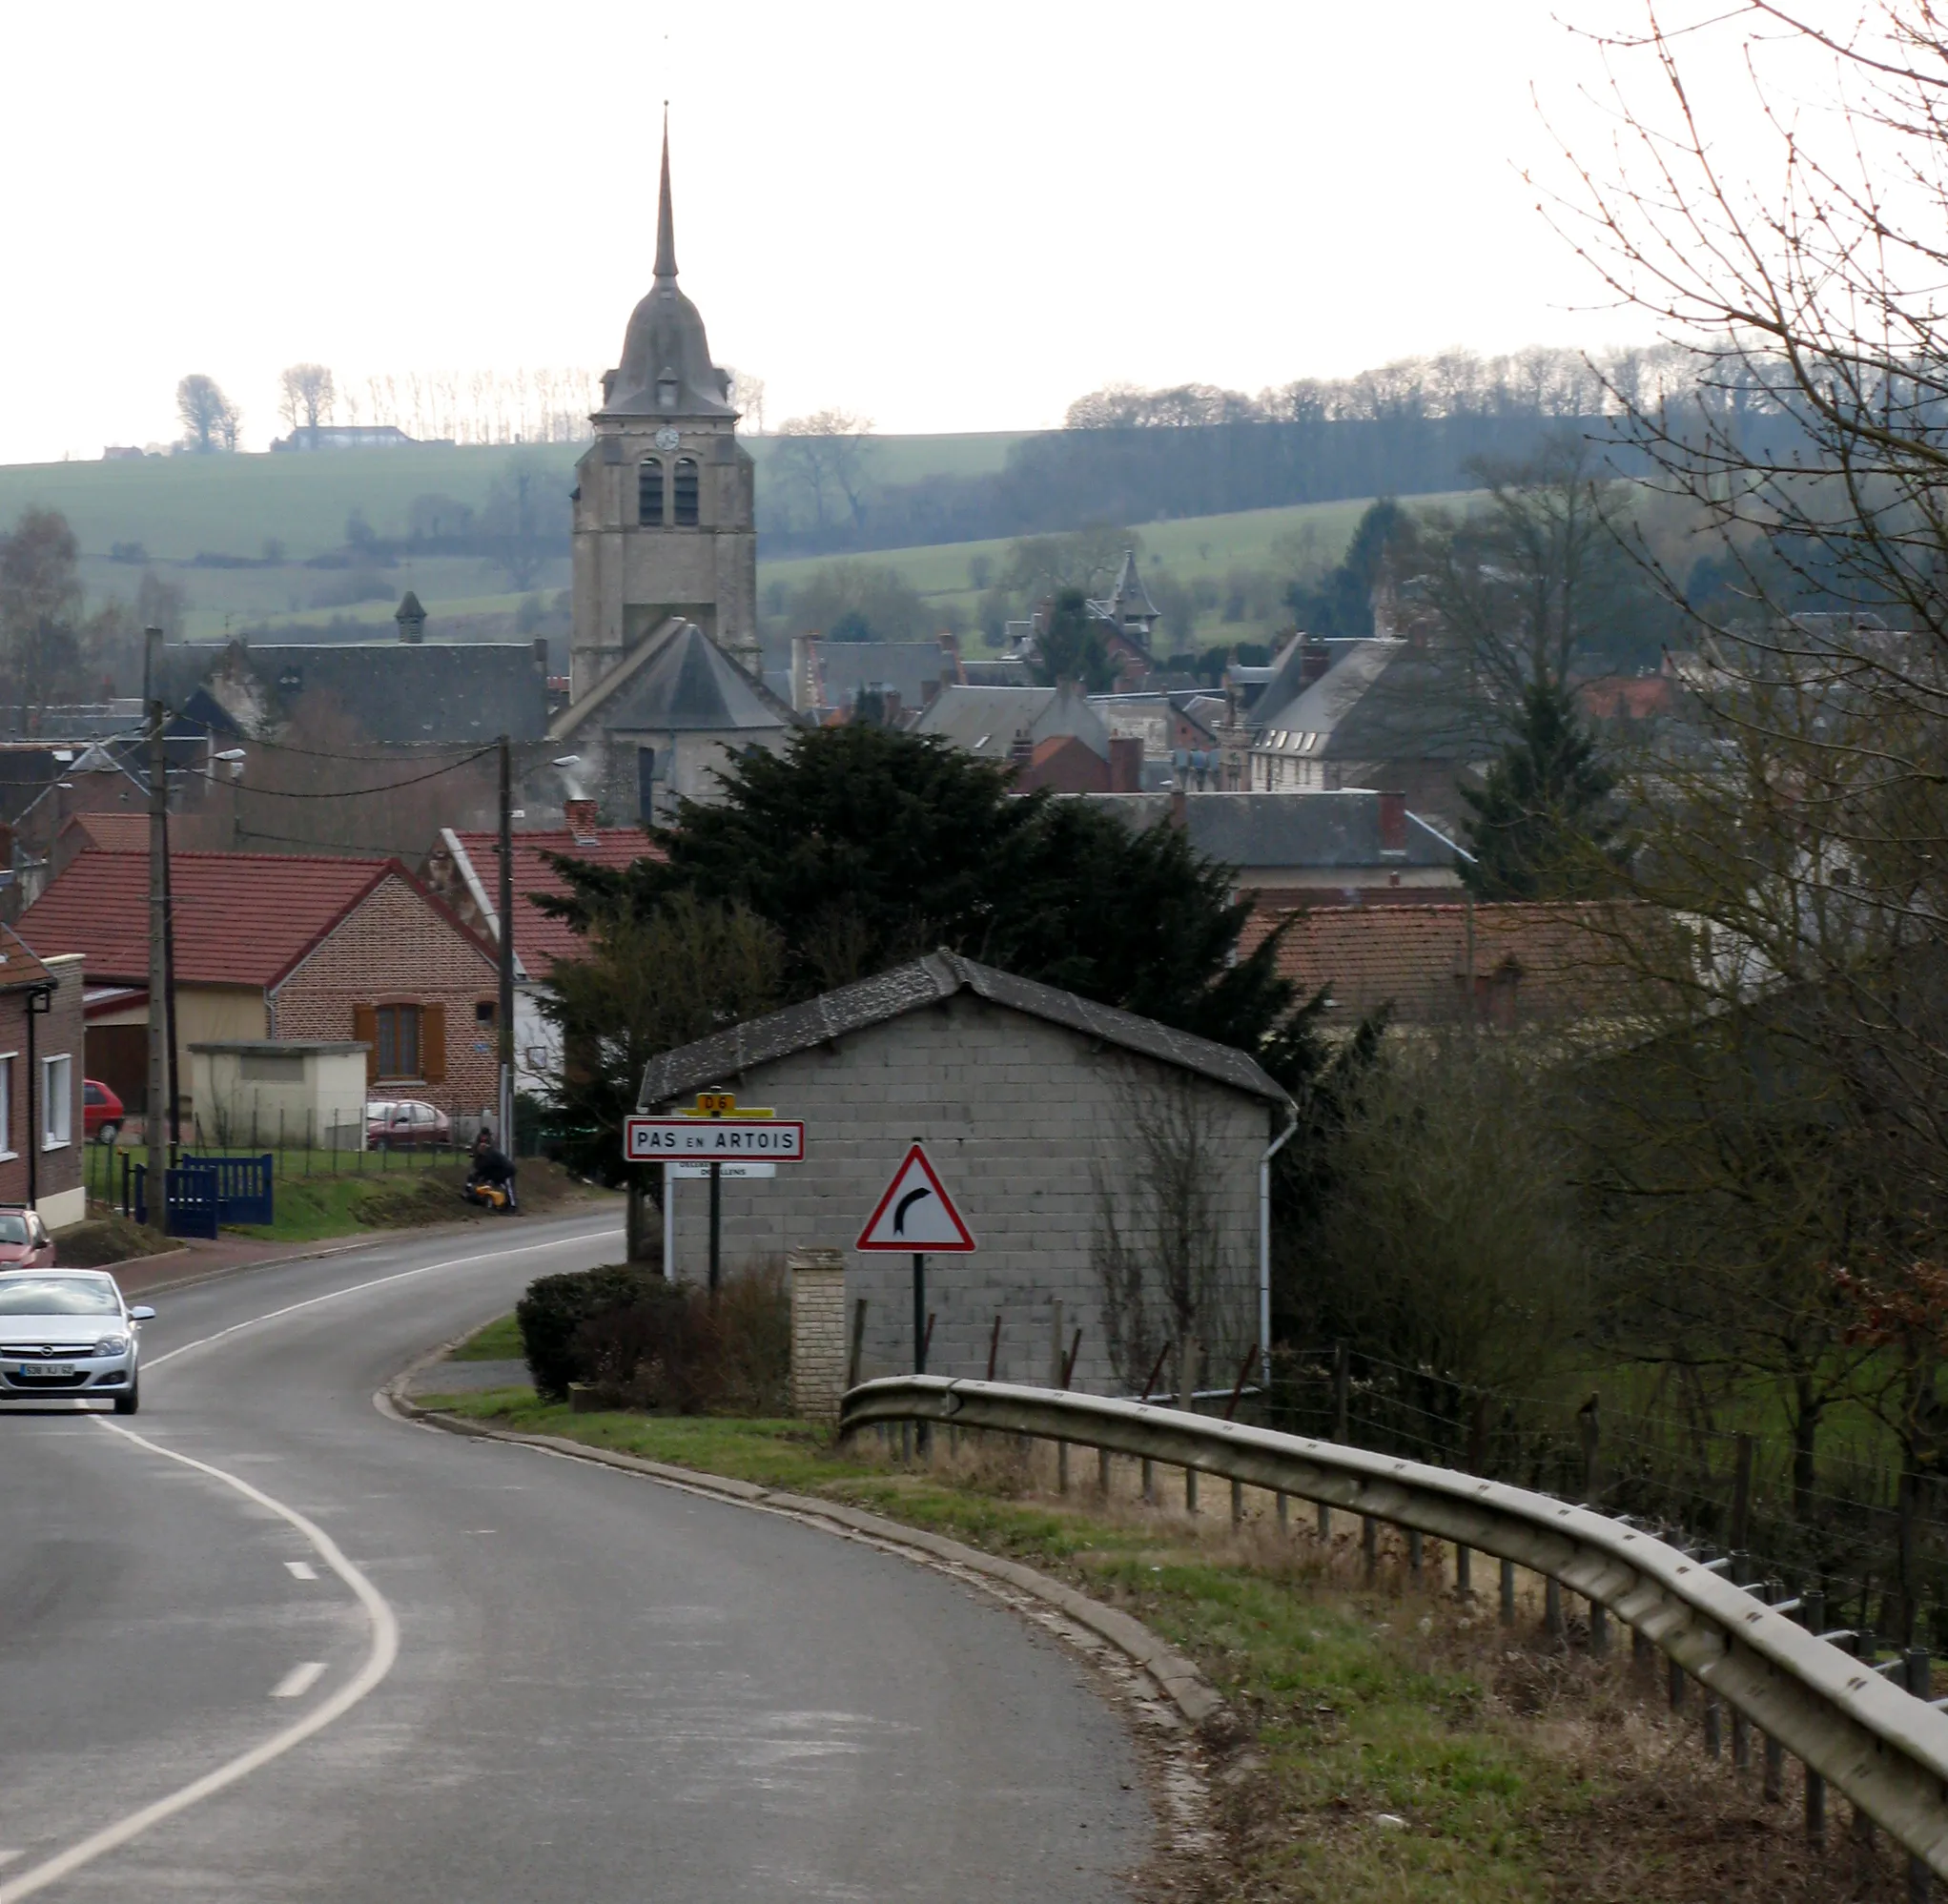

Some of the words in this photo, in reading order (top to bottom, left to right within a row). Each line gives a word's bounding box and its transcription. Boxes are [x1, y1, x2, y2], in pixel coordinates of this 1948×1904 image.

[637, 1132, 676, 1148] PAS
[687, 1137, 704, 1148] EN
[715, 1133, 793, 1149] ARTOIS
